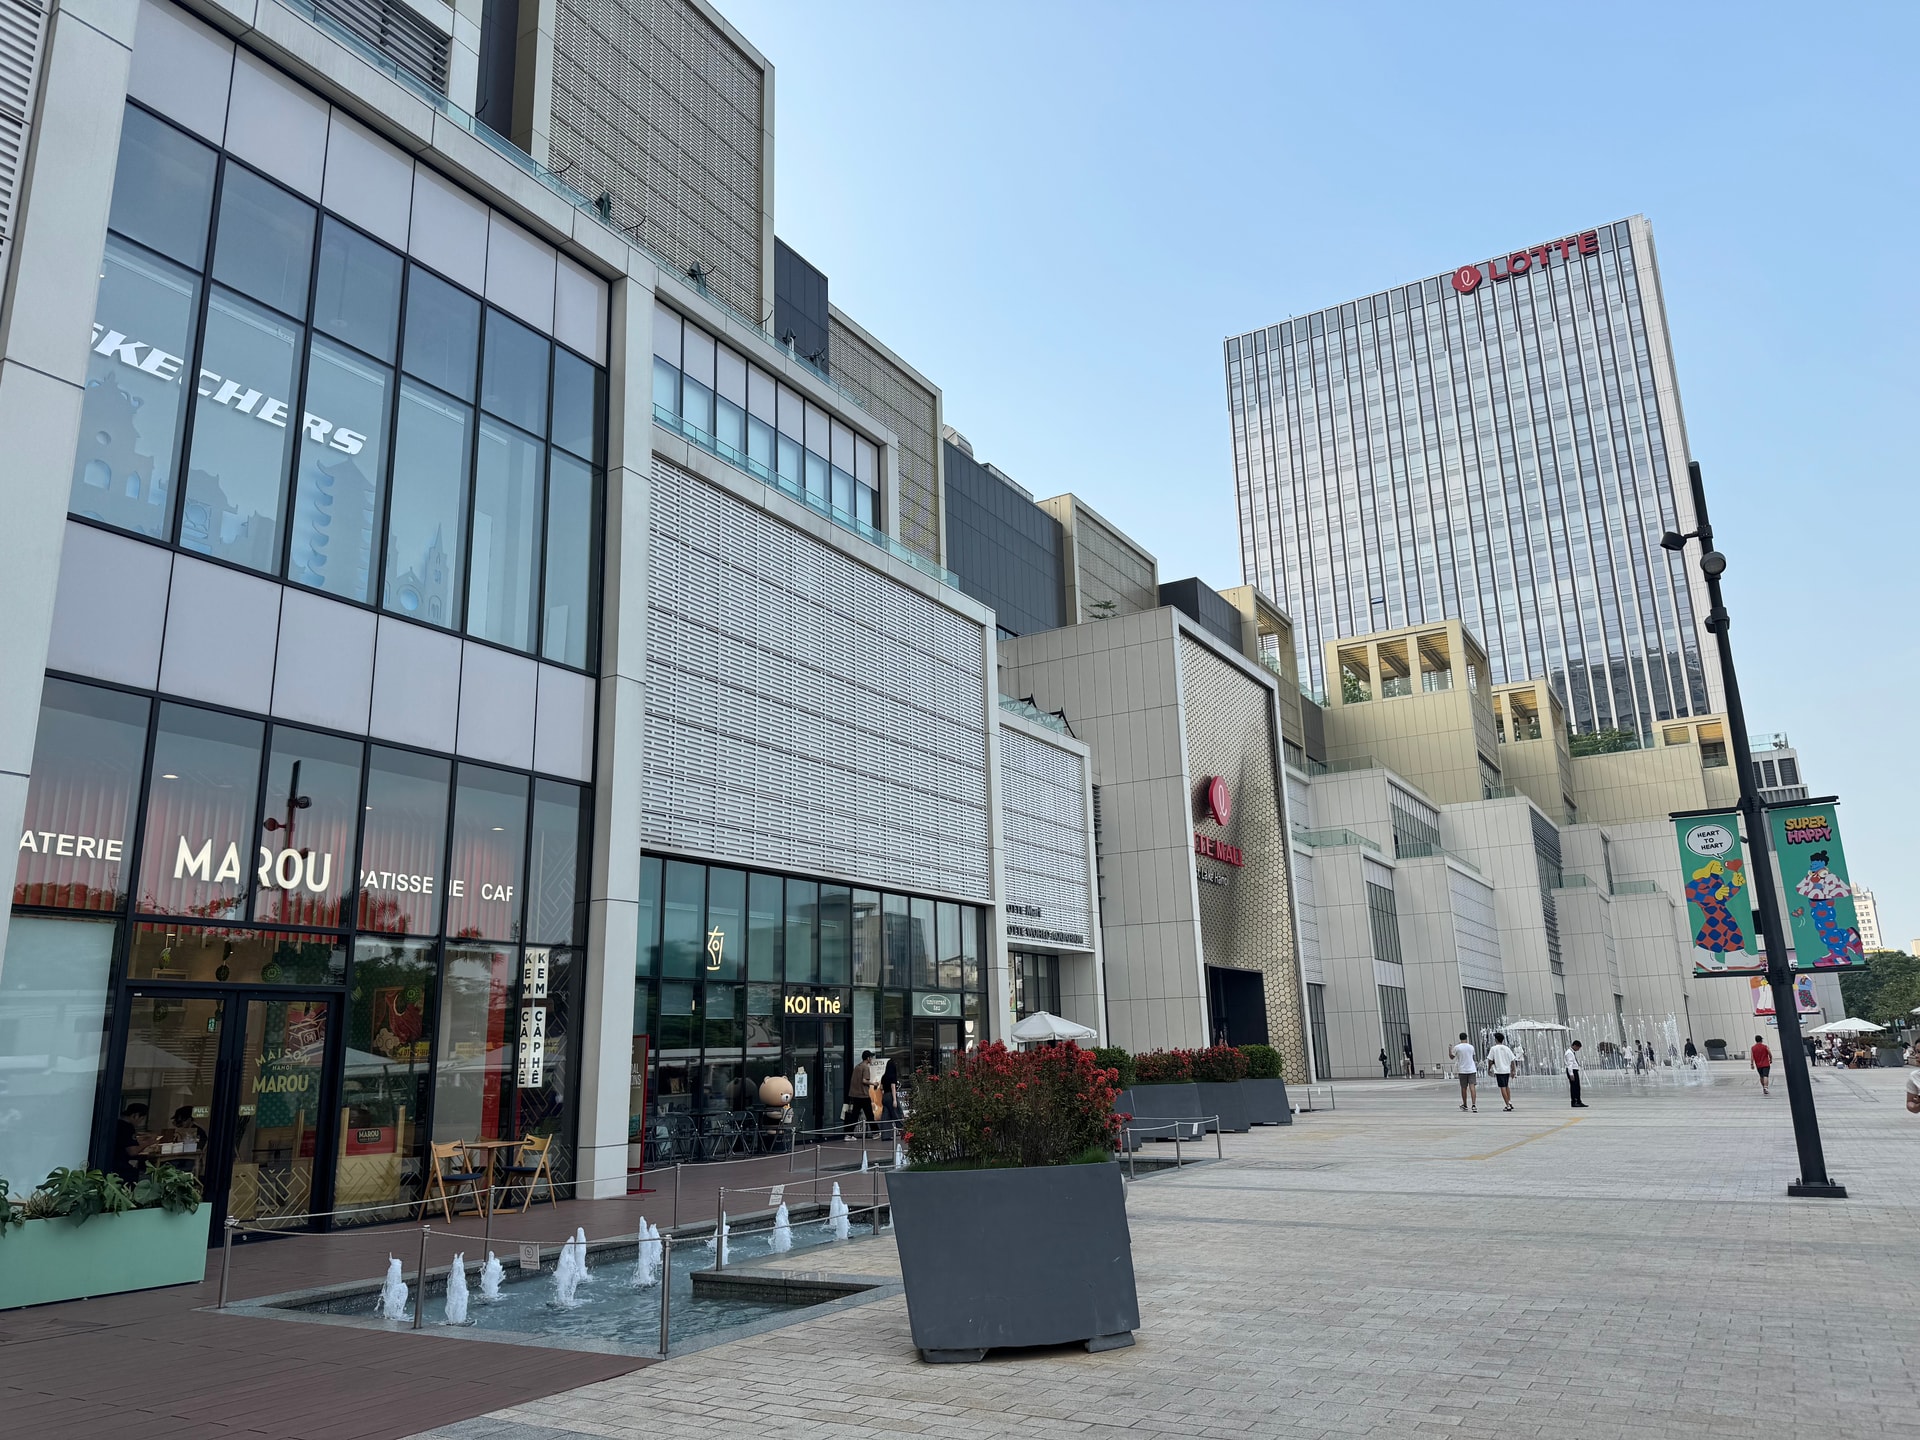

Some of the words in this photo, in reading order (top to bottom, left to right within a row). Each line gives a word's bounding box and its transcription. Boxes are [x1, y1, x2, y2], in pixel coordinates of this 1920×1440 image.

[1489, 231, 1599, 280] LOTTE
[1785, 815, 1828, 831] SUPER
[1697, 829, 1720, 838] HEART
[1787, 827, 1832, 845] HAPPY
[1216, 840, 1244, 867] MALL
[1700, 842, 1724, 851] HEART
[173, 835, 332, 893] MAROU
[535, 953, 546, 995] KEM
[784, 995, 811, 1014] KOI
[815, 996, 841, 1014] Thé
[255, 1048, 311, 1067] MAISON
[252, 1074, 309, 1094] MAROU
[358, 1130, 380, 1138] MAROU
